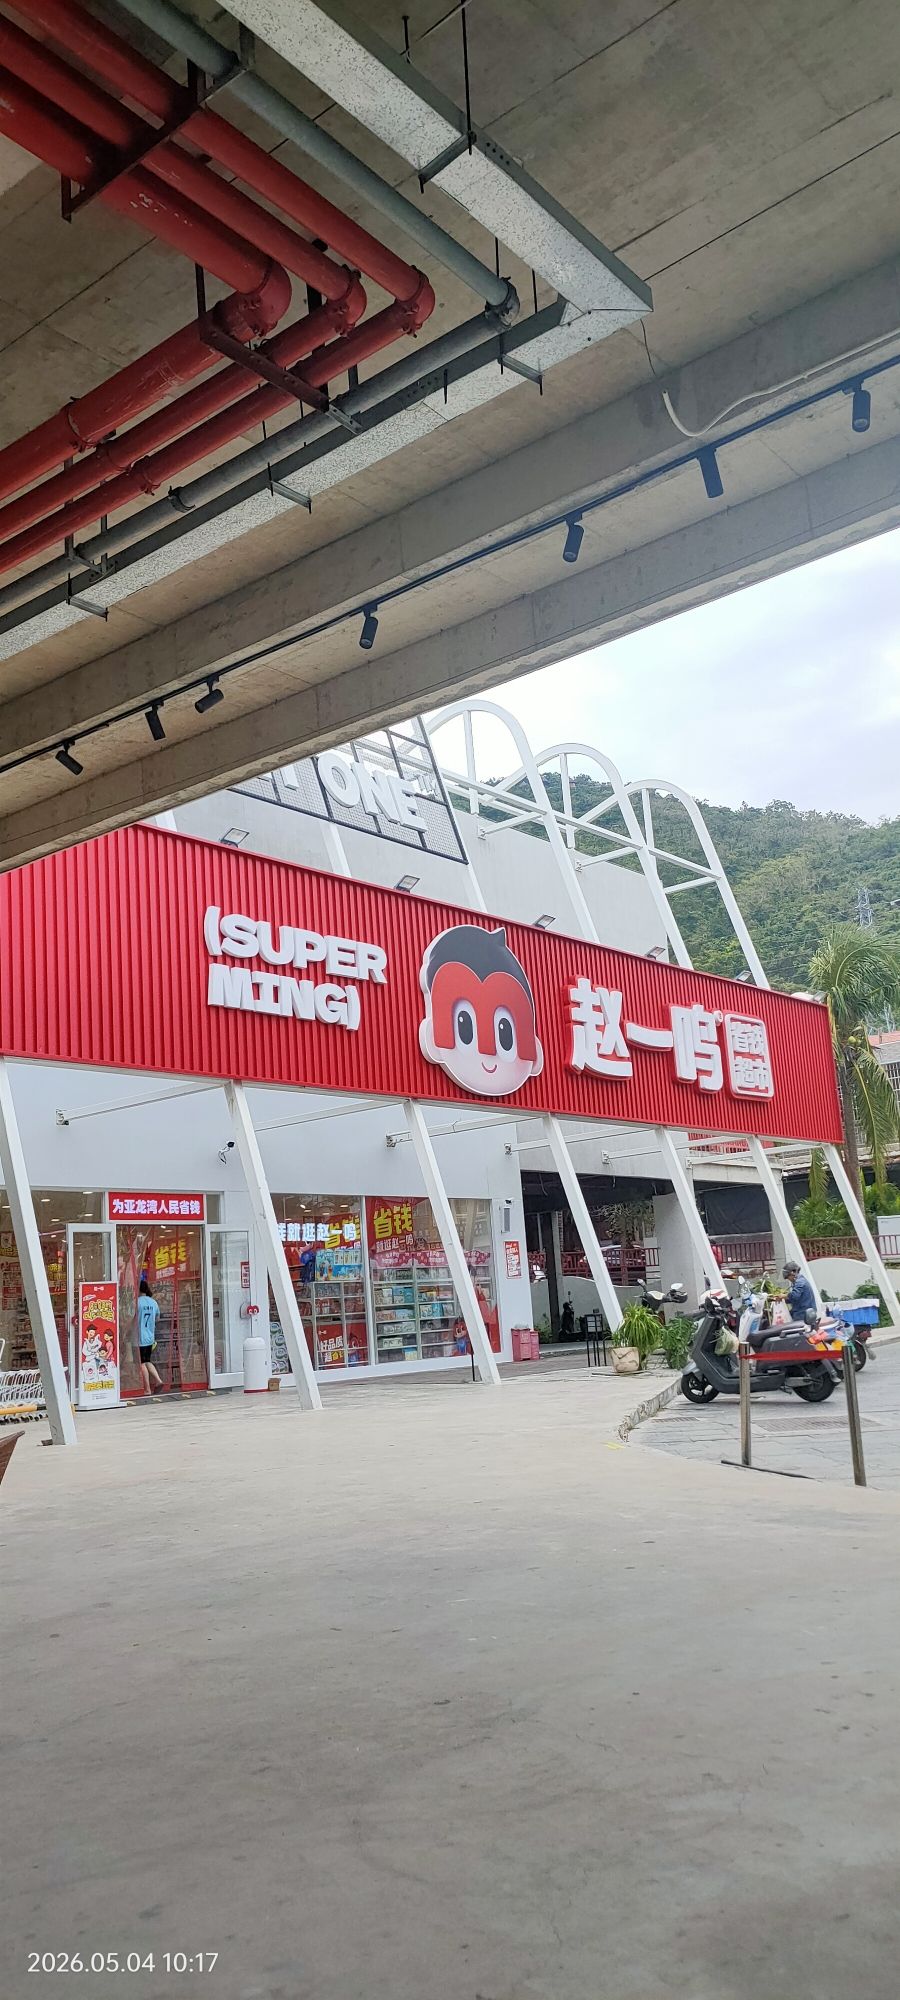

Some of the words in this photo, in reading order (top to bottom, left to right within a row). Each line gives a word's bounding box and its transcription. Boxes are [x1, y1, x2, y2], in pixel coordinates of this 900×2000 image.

[317, 752, 429, 832] ONE
[204, 905, 388, 984] (SUPER
[207, 963, 361, 1031] MING)
[112, 1198, 200, 1215] 为亚龙湾人民省钱
[373, 1202, 413, 1240] 省钱
[143, 1313, 151, 1328] 7
